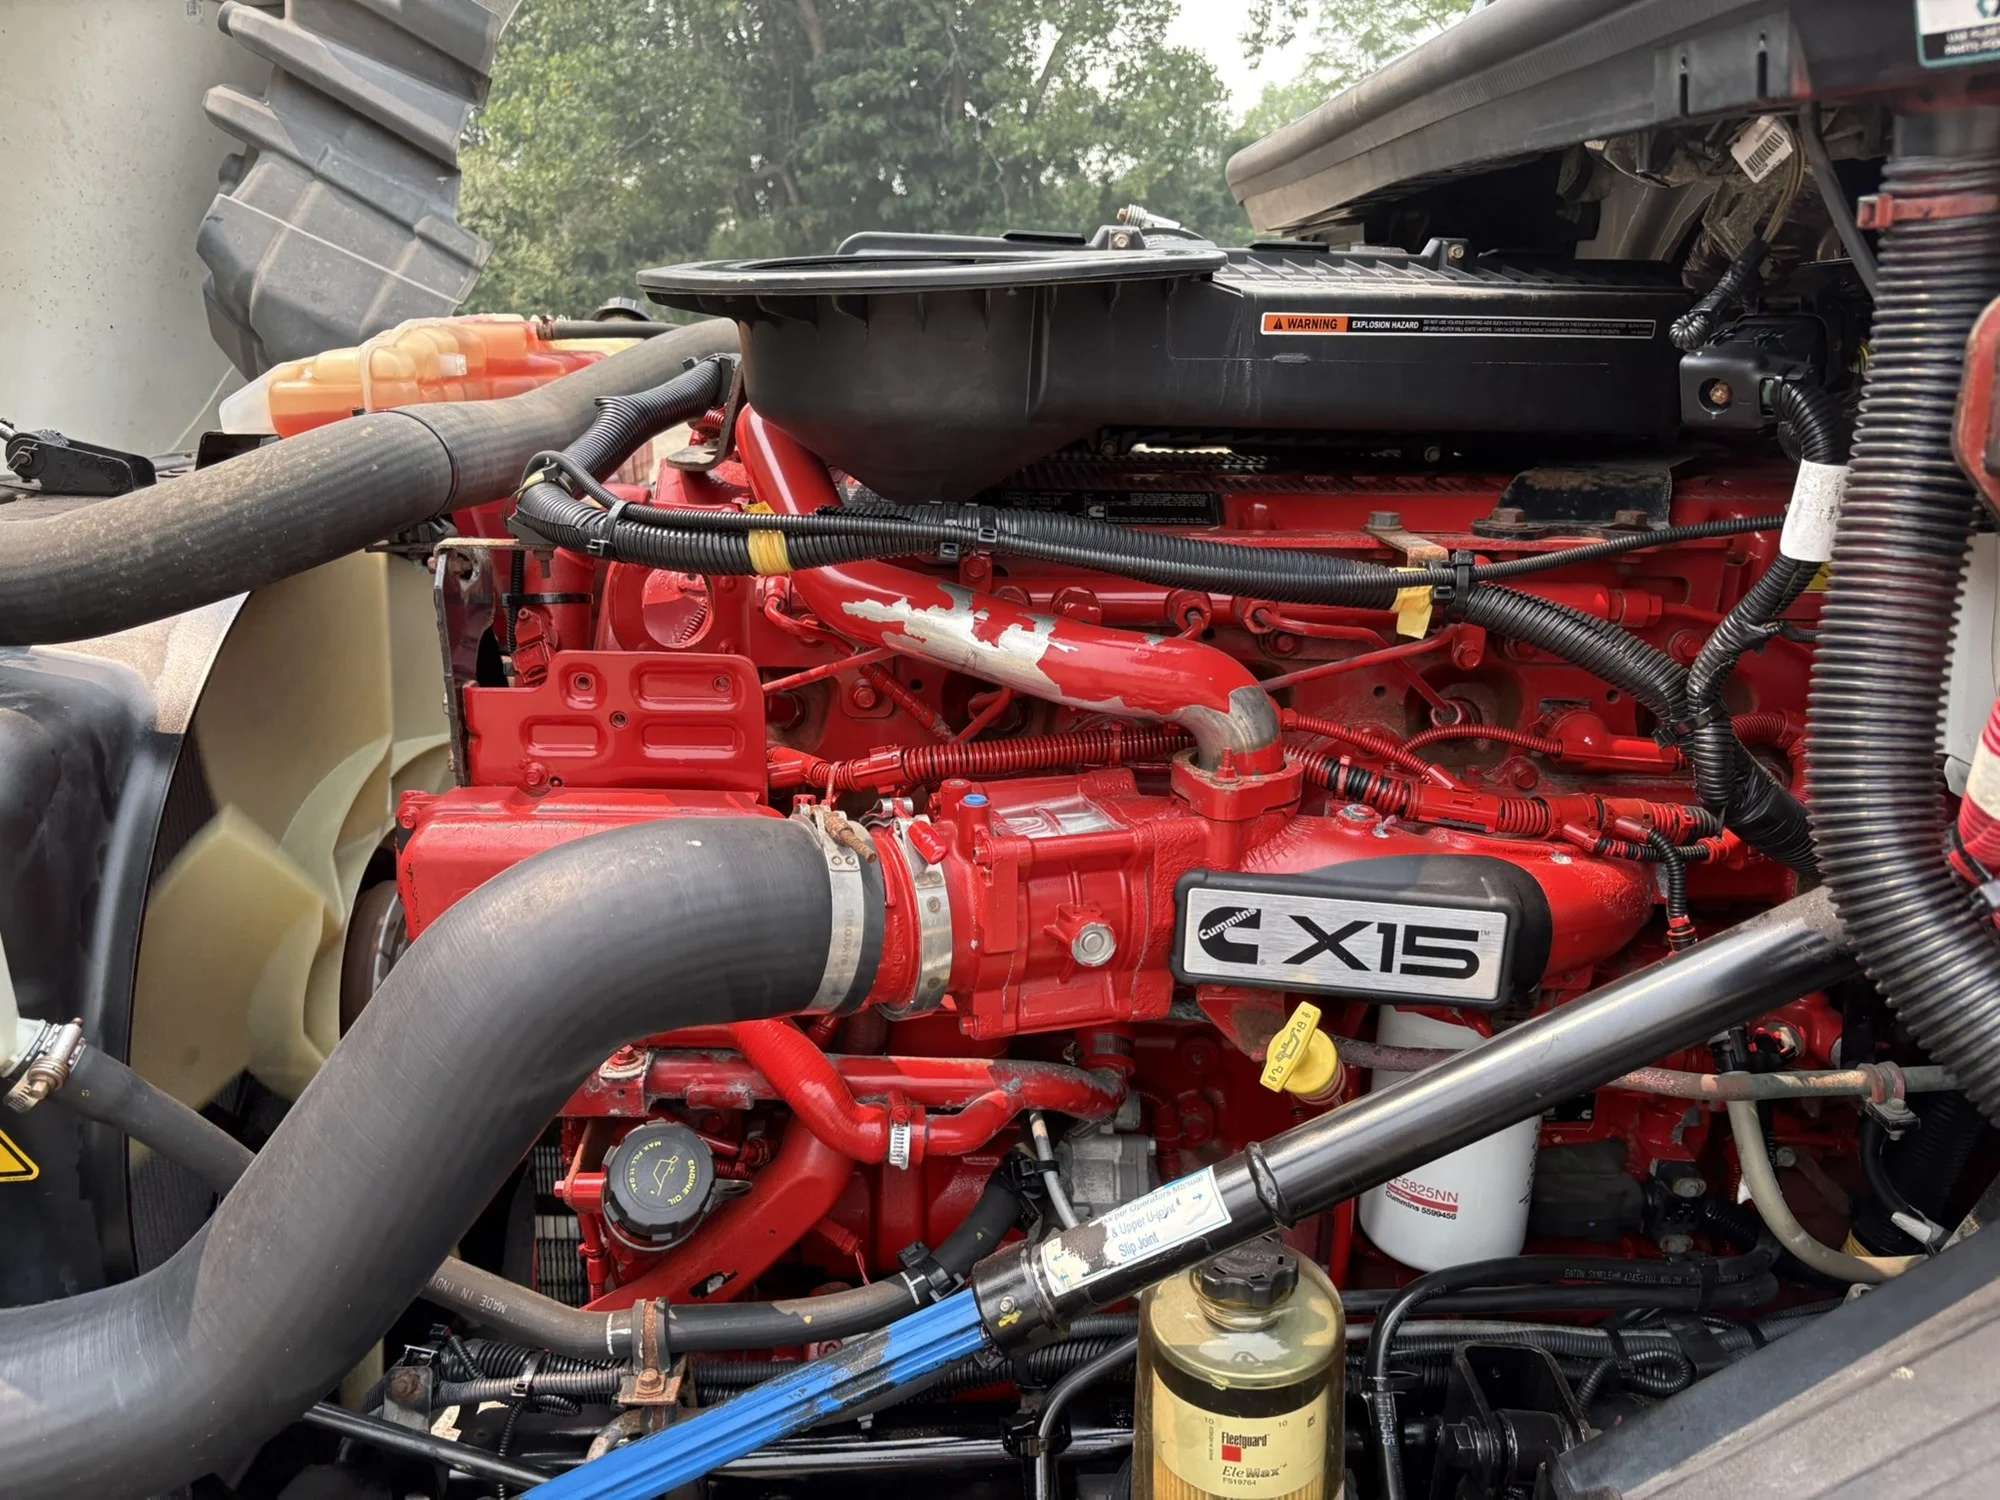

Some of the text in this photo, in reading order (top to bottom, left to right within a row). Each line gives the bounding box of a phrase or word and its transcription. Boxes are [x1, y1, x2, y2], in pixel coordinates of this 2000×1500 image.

[1287, 317, 1338, 331] WARNING
[1352, 320, 1419, 330] EXPLOSION HAZARD
[1198, 906, 1257, 941] Cummins
[1281, 914, 1480, 980] X15
[643, 1140, 662, 1151] MAX
[631, 1150, 644, 1164] FILL
[628, 1177, 639, 1194] GAL
[667, 1159, 696, 1206] ENGINE OIL
[1393, 1176, 1459, 1204] F5825NN
[1114, 1208, 1128, 1222] per
[1130, 1190, 1172, 1212] Operators
[1172, 1175, 1204, 1194] Manual
[1386, 1190, 1420, 1212] Cummins
[1111, 1203, 1176, 1239] & Upper U-joint
[1118, 1231, 1159, 1258] Slip Joint
[429, 1275, 508, 1314] MADE IN INDI
[1204, 1416, 1215, 1426] 10
[1278, 1420, 1288, 1428] 10
[1221, 1431, 1268, 1449] Fleetguard
